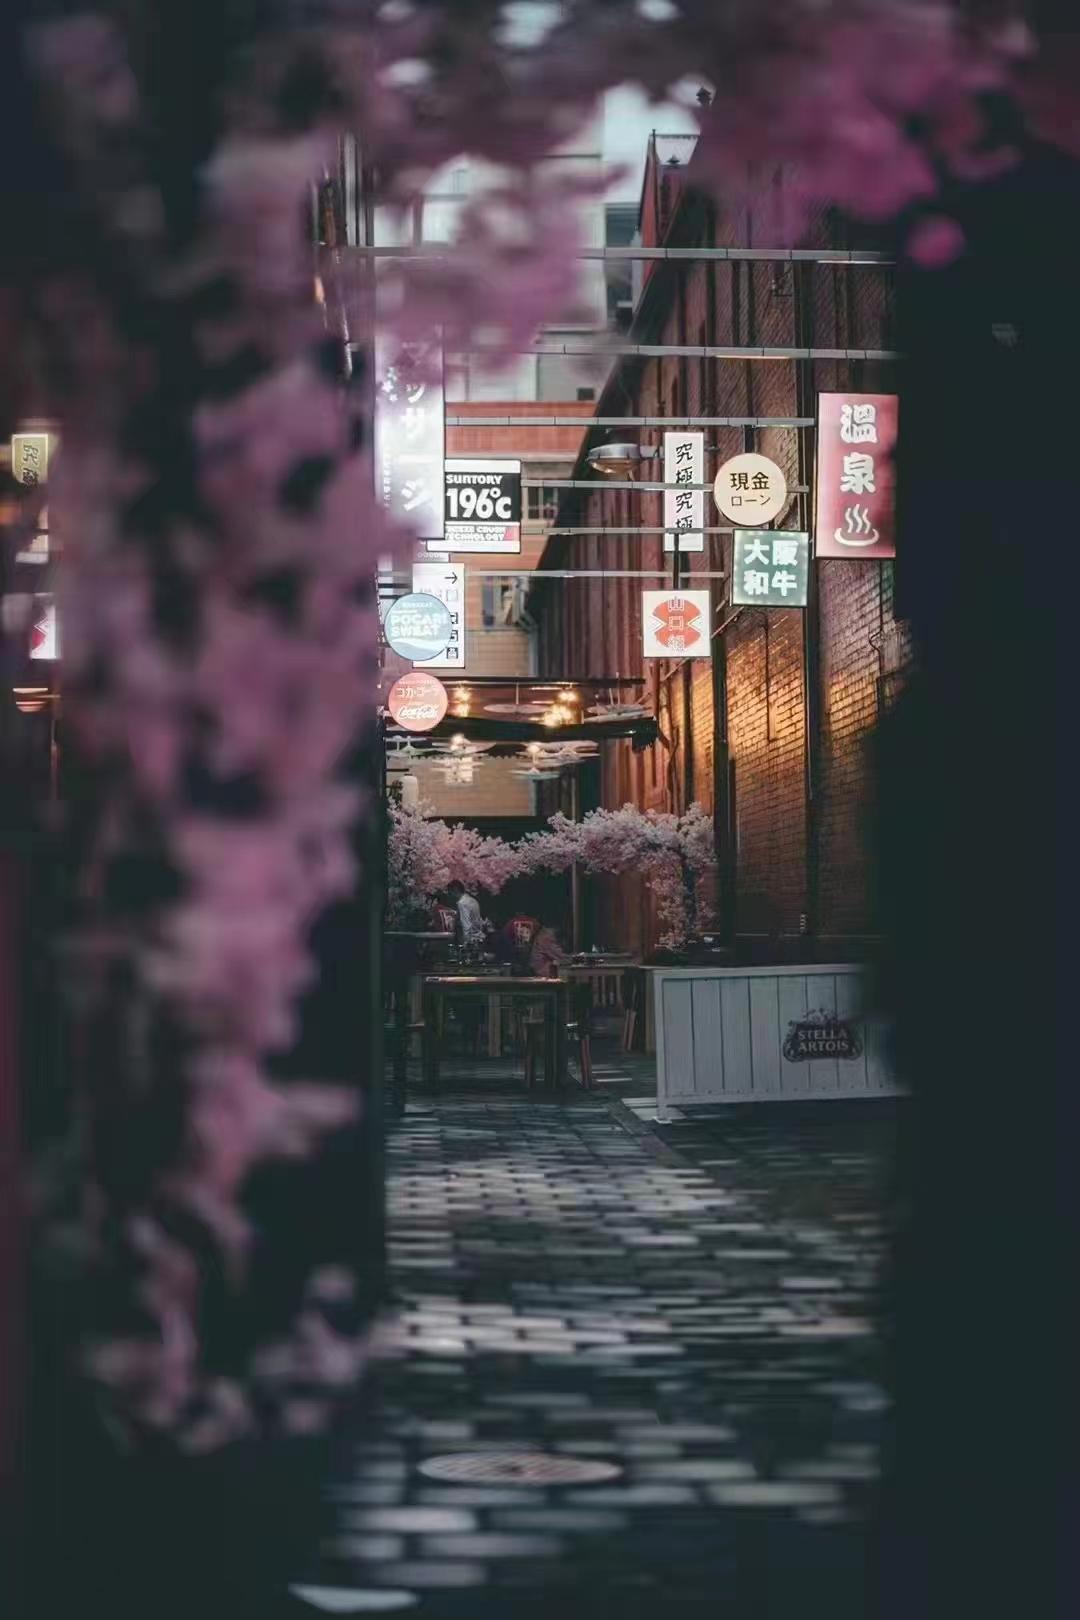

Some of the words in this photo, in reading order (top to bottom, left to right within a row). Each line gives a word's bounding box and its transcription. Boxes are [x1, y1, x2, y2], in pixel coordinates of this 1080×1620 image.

[730, 471, 770, 490] 現金
[731, 494, 771, 507] ローン
[743, 539, 798, 566] 大阪
[743, 570, 797, 597] 和牛
[391, 625, 440, 638] SWEAT
[798, 1029, 849, 1040] STELLA
[800, 1040, 849, 1053] ARTOIS
